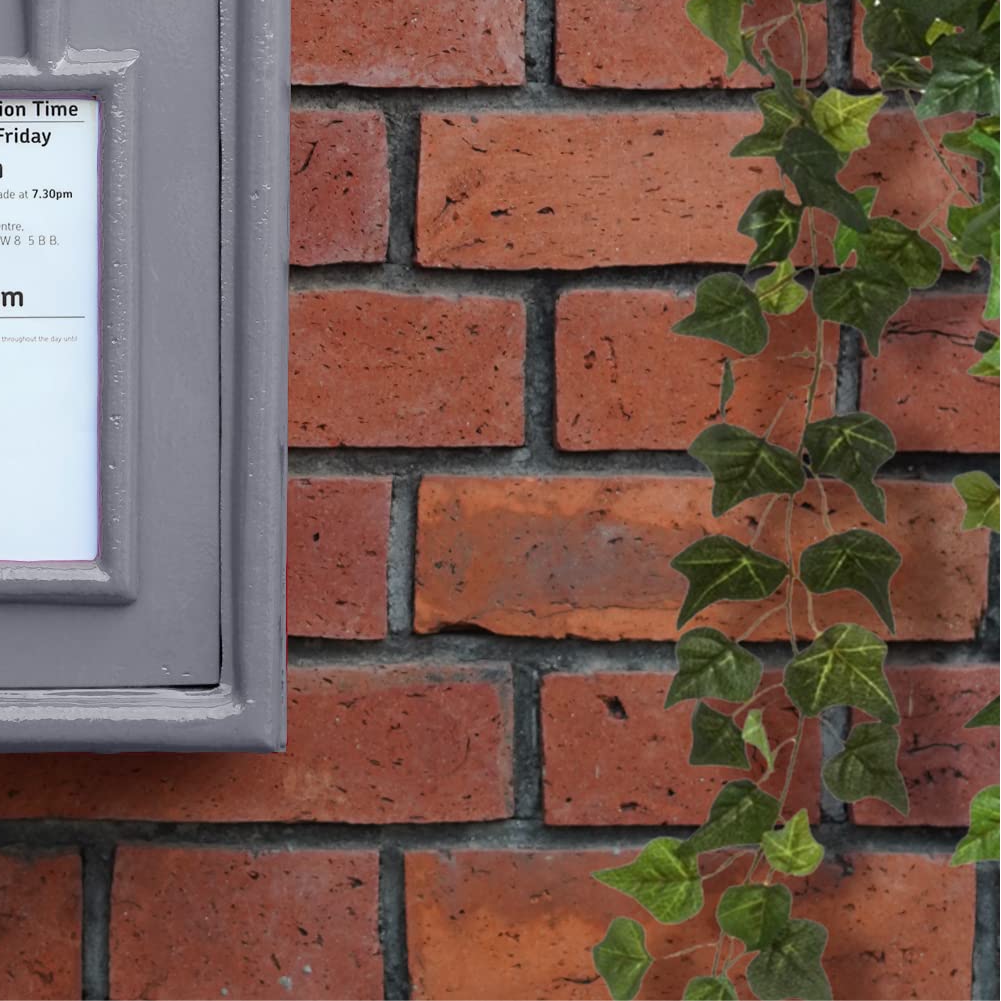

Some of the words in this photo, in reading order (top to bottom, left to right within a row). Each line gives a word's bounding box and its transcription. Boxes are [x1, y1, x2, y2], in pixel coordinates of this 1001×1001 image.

[32, 101, 78, 117] Time
[19, 191, 28, 199] at
[32, 189, 72, 200] 7.30pm
